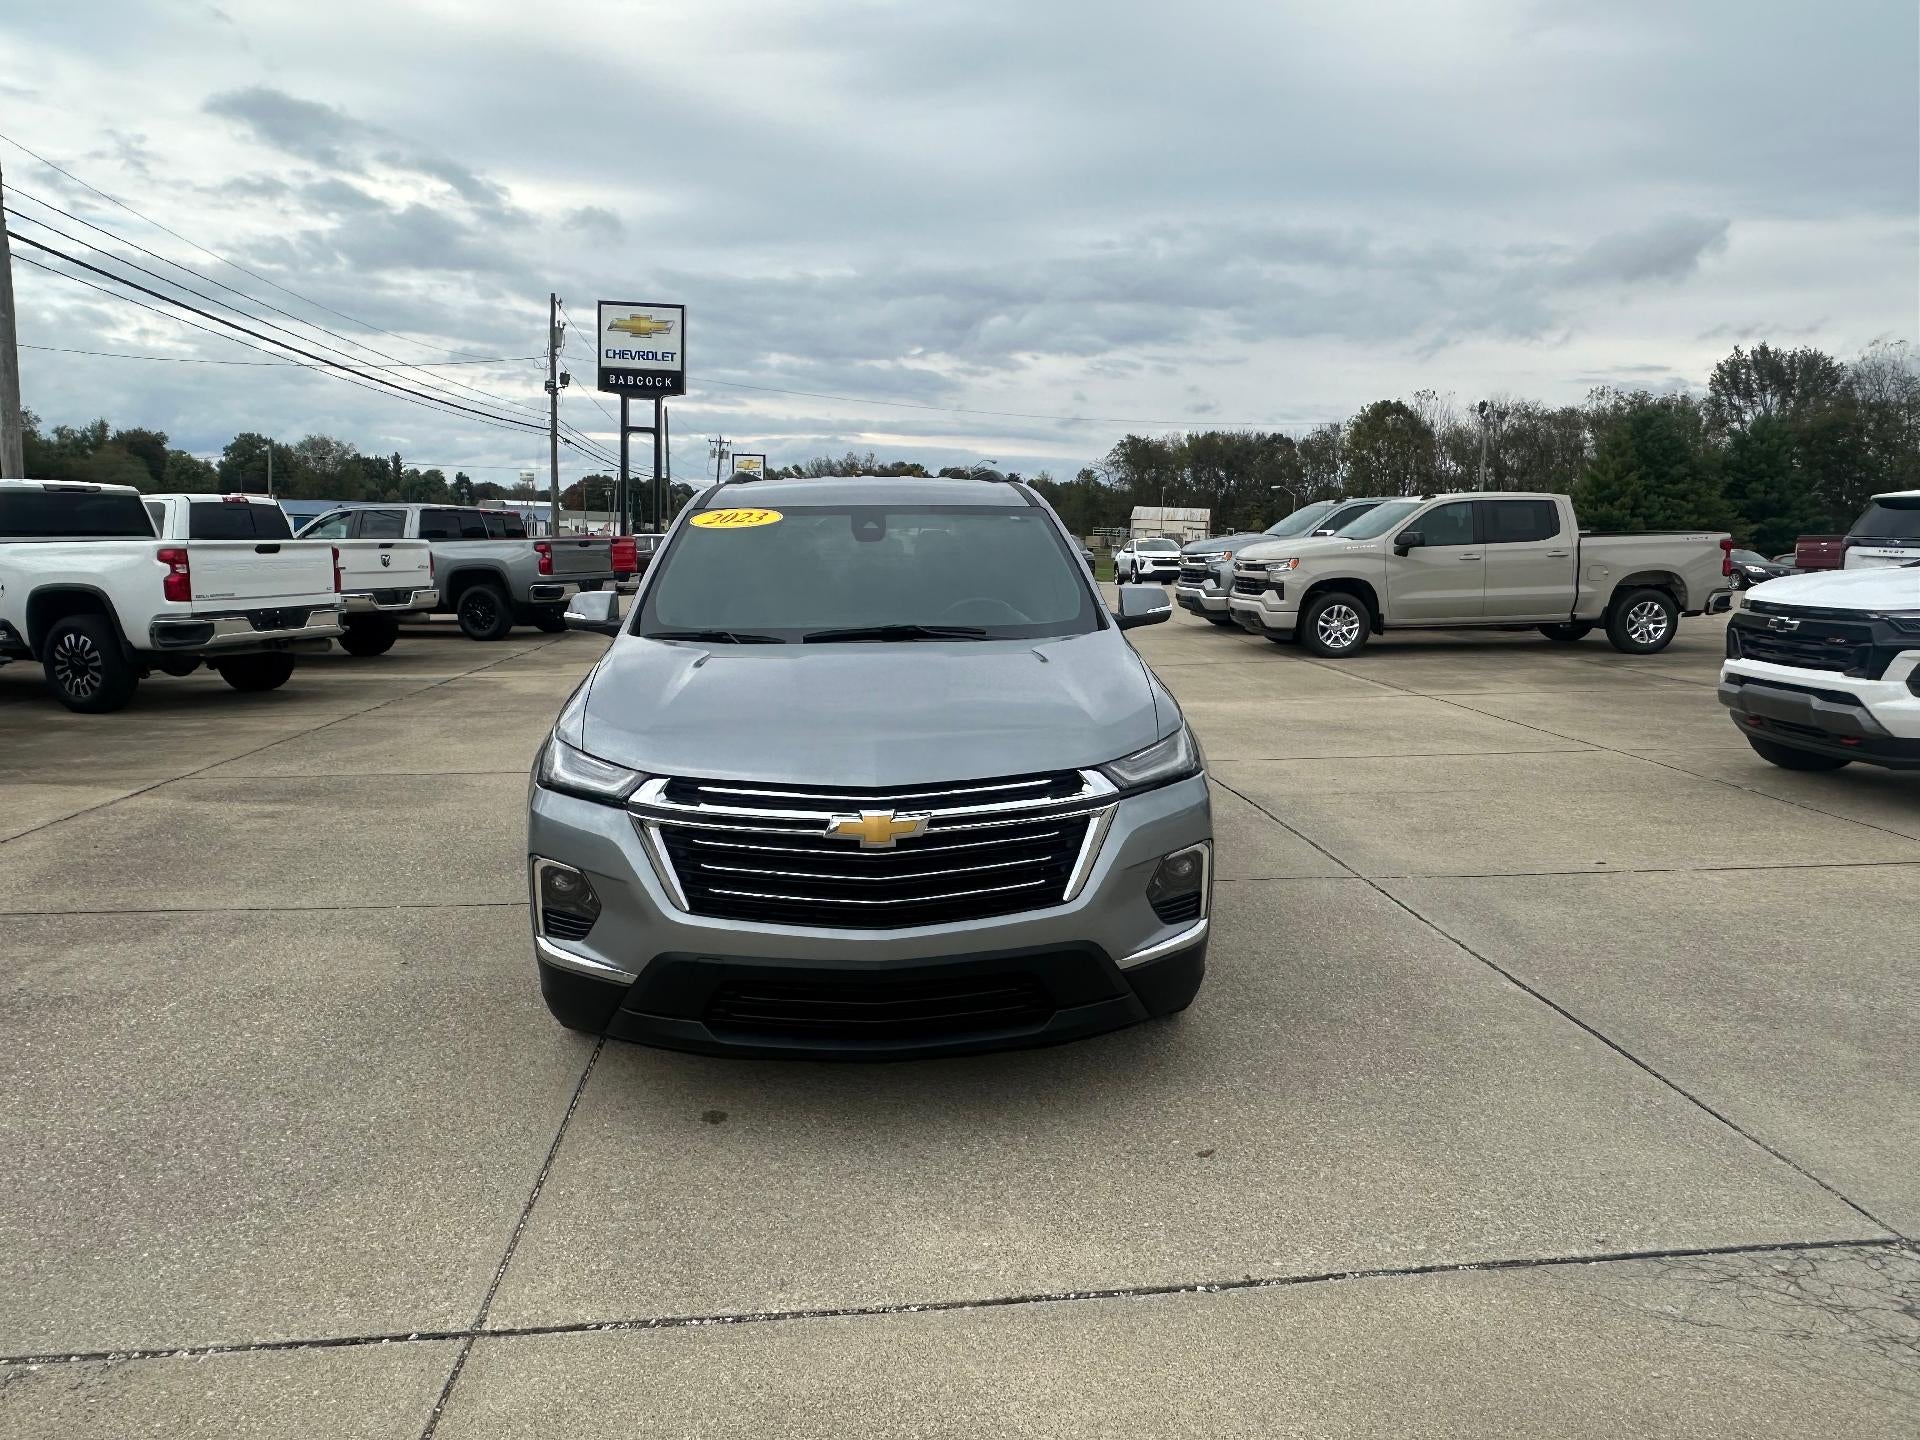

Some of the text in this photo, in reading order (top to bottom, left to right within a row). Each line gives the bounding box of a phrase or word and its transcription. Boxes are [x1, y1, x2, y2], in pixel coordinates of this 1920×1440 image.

[605, 349, 677, 362] CHEVROLET
[609, 374, 672, 387] BABCOCK
[702, 512, 769, 525] 2023
